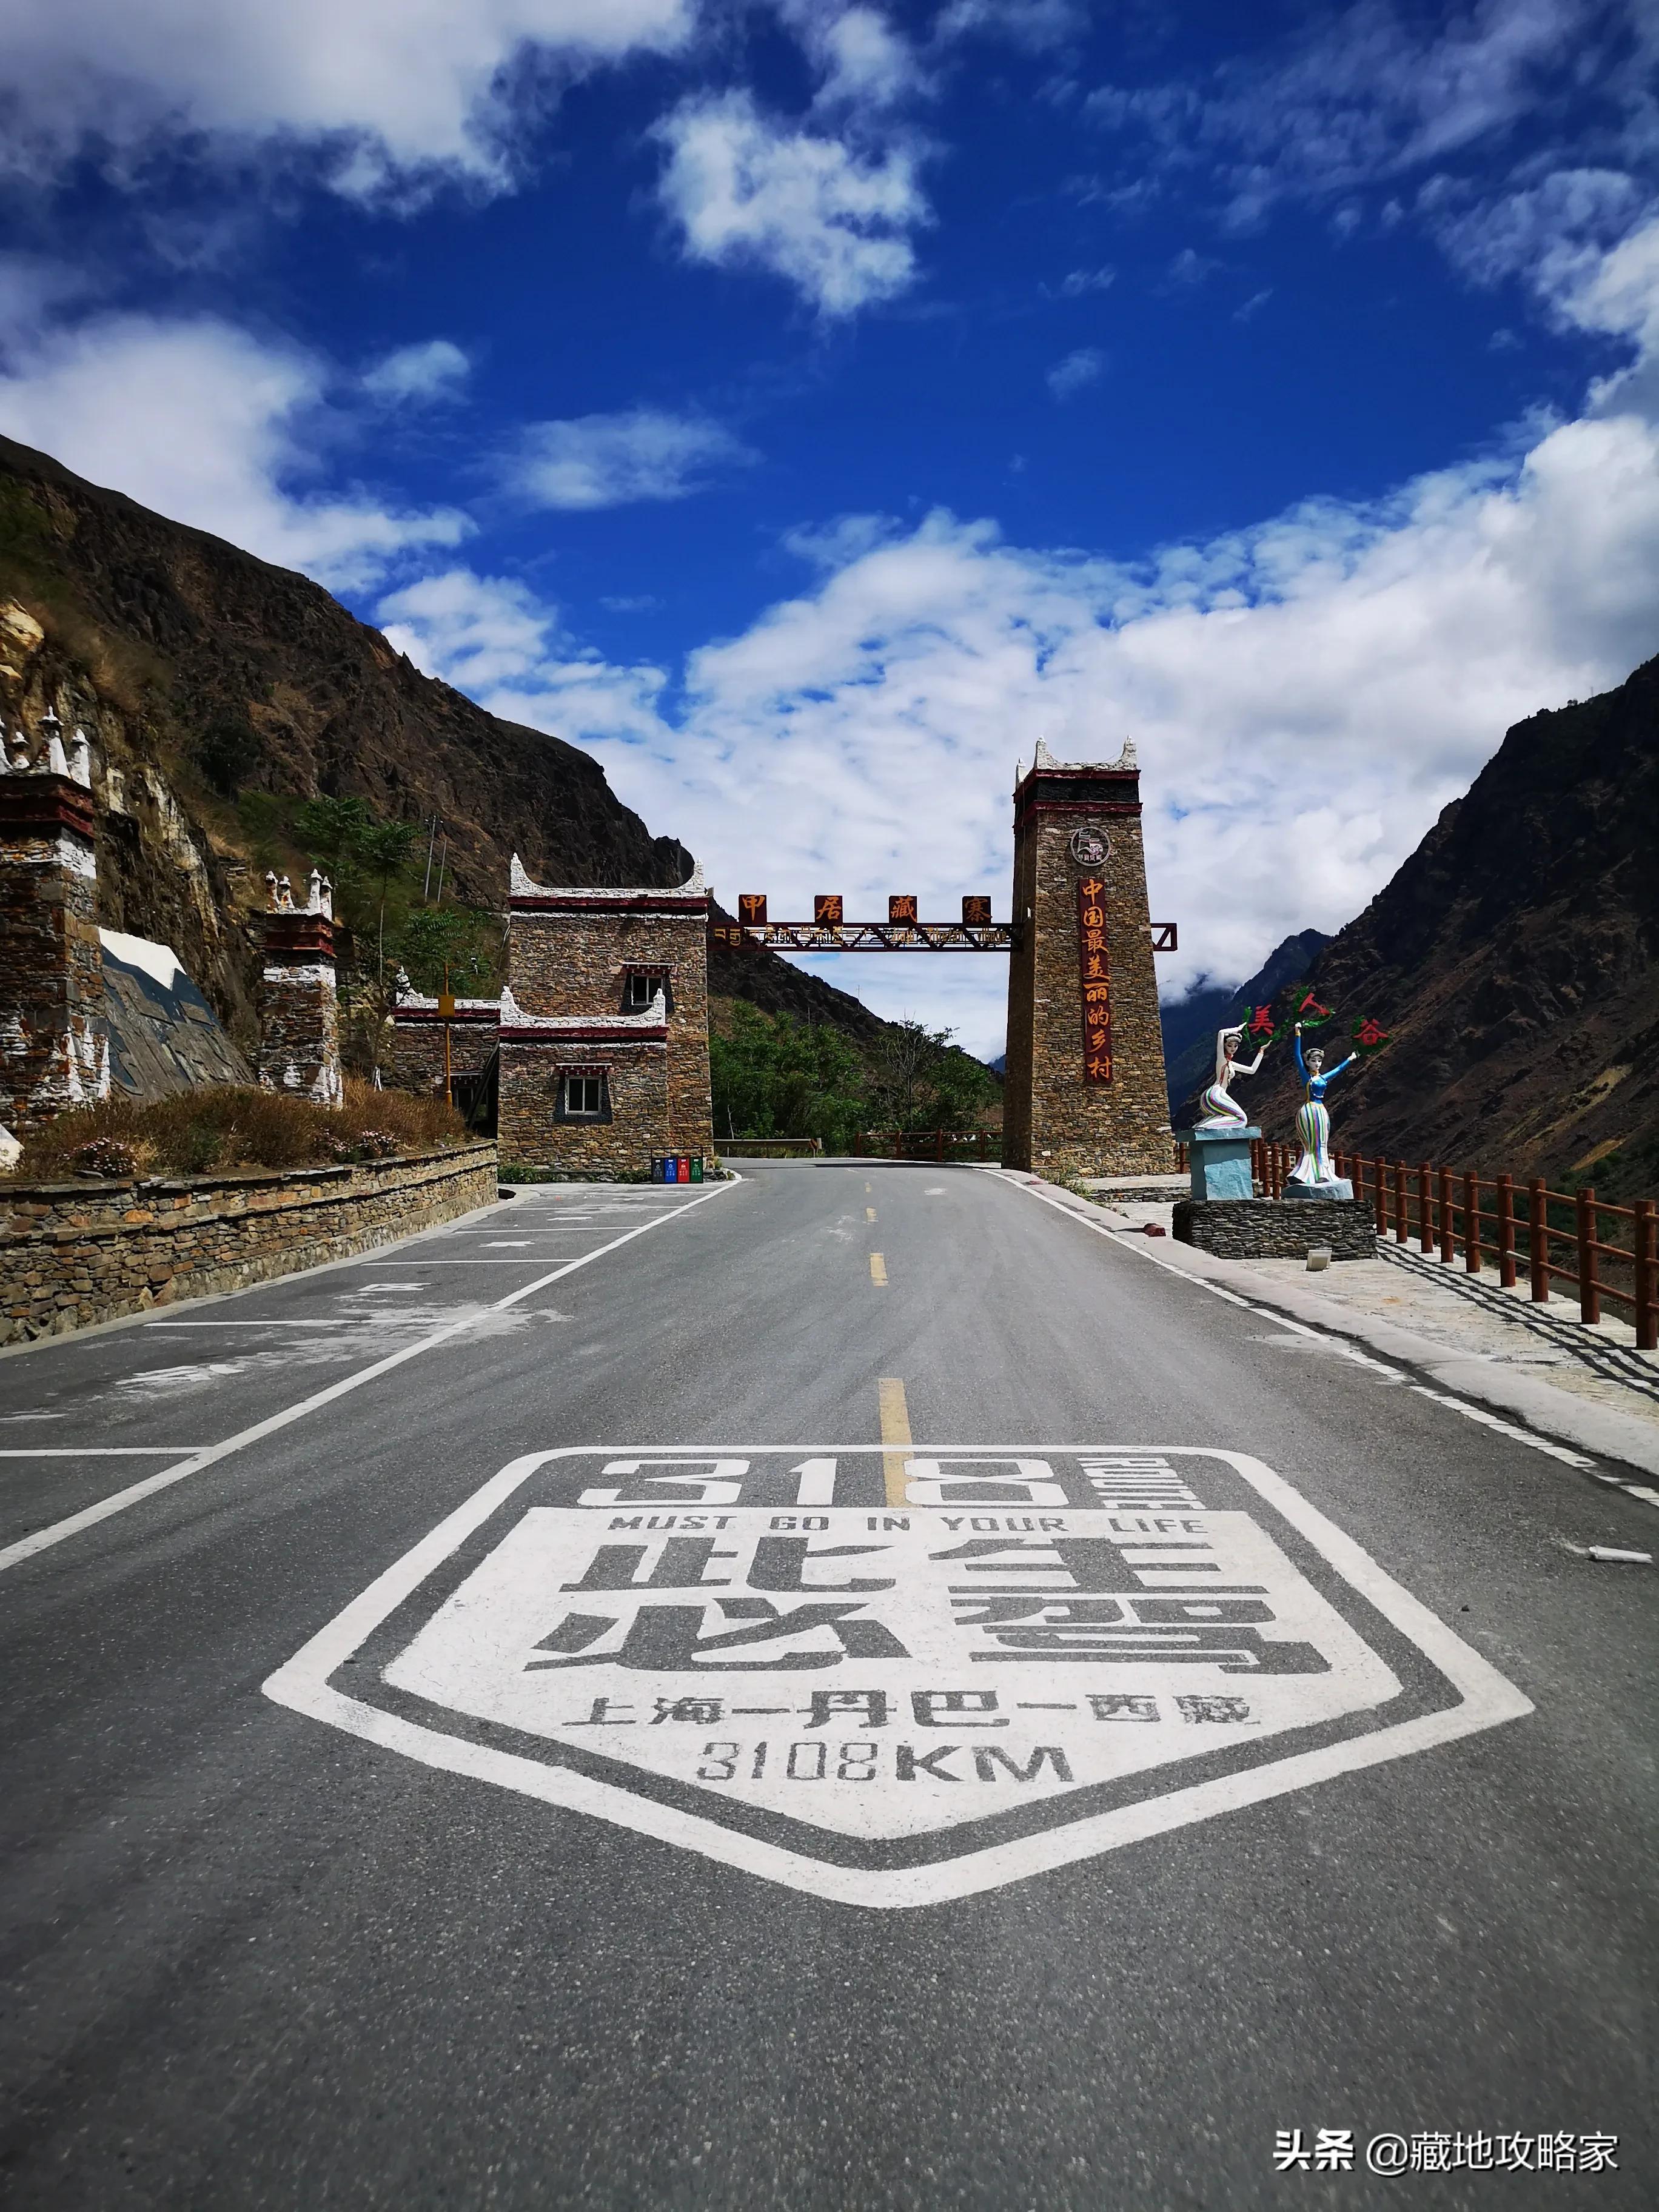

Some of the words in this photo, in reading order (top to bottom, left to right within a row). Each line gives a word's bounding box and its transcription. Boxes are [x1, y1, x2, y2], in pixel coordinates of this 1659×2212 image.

[742, 895, 992, 922] 甲居藏寨
[1082, 879, 1112, 1079] 中国最美丽的乡村
[1248, 993, 1389, 1045] 美人谷
[577, 1458, 1069, 1506] 318
[1077, 1457, 1207, 1510] ROUTE
[607, 1516, 737, 1531] MUST
[769, 1517, 830, 1531] GO
[867, 1517, 910, 1532] IN
[940, 1517, 1069, 1532] YOUR
[1107, 1518, 1209, 1533] LIFE
[558, 1537, 1271, 1594] 此生
[522, 1596, 1334, 1675] 必驾
